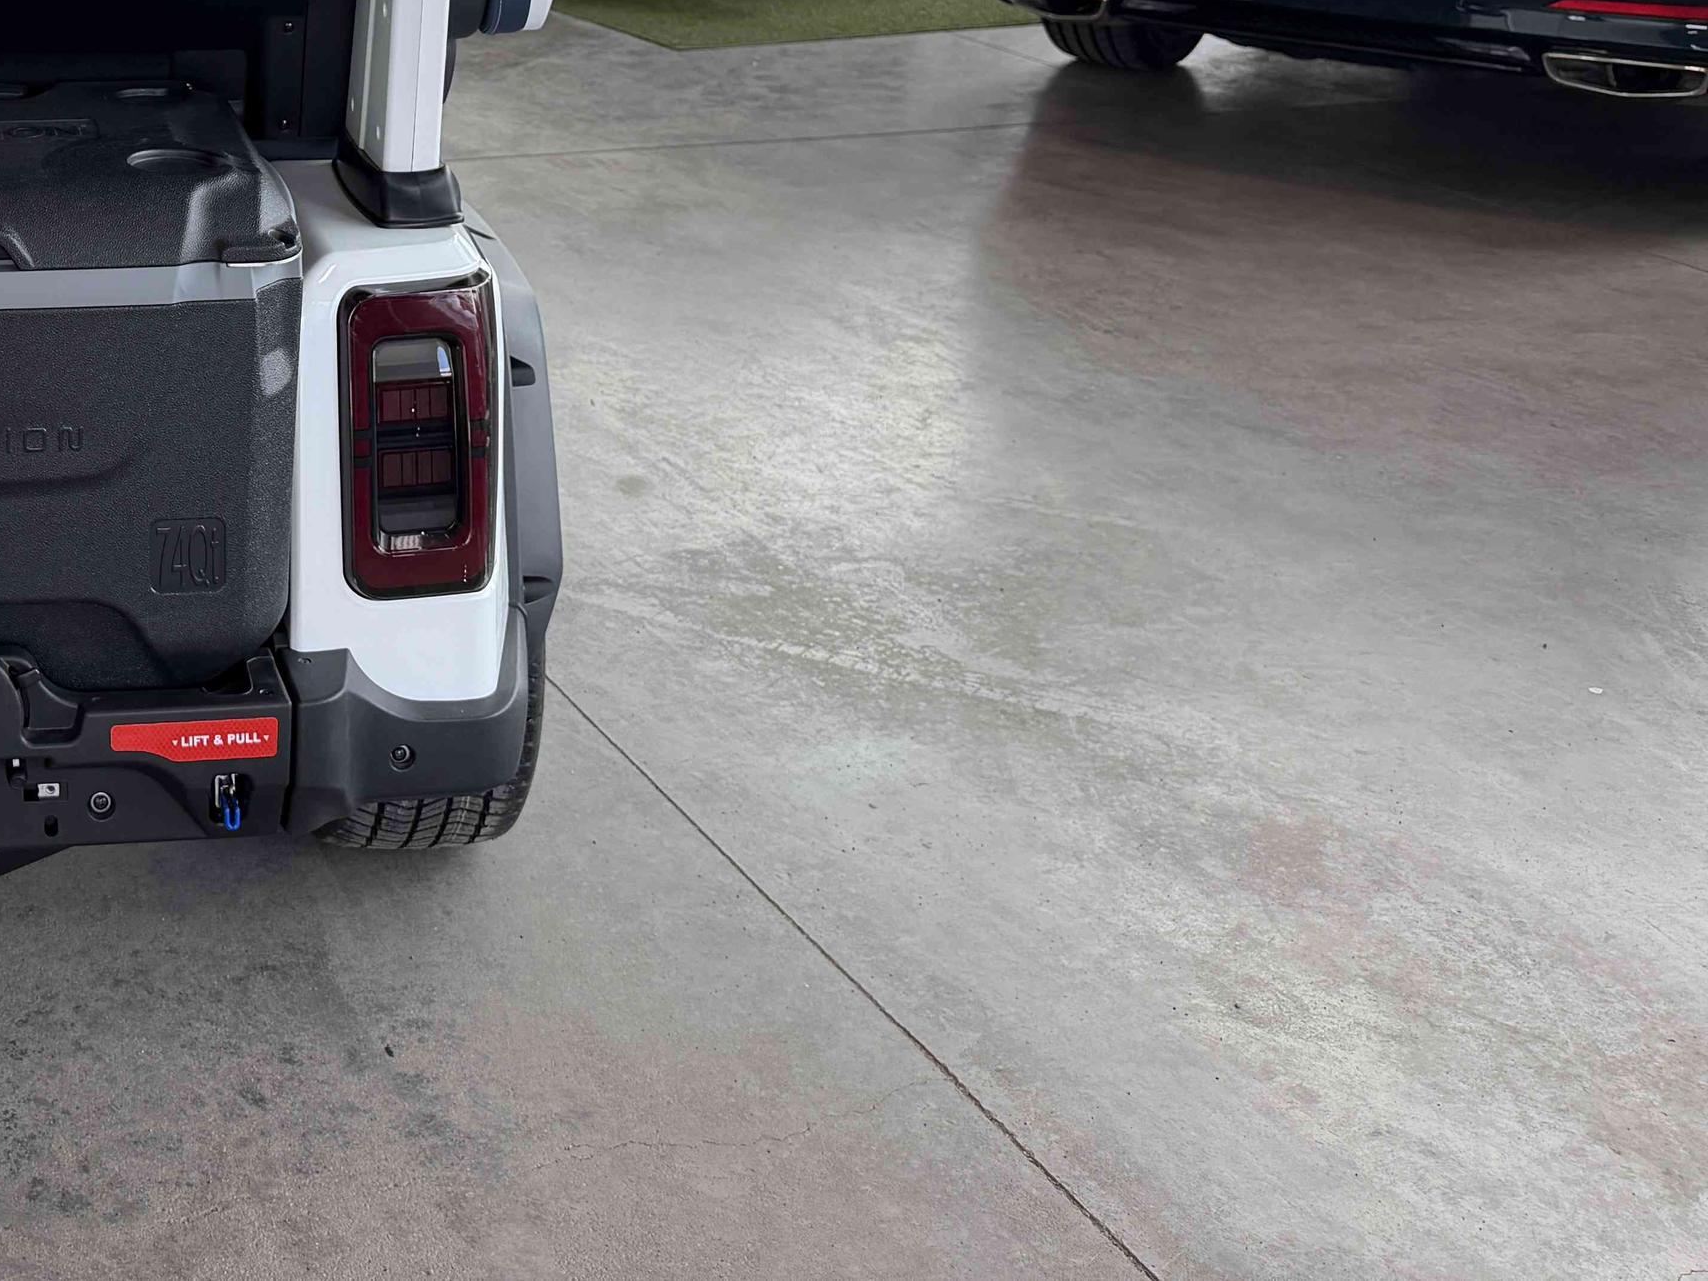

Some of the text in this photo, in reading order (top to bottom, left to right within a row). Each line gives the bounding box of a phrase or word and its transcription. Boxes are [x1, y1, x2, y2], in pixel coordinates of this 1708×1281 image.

[181, 732, 261, 747] LIFT & PULL
